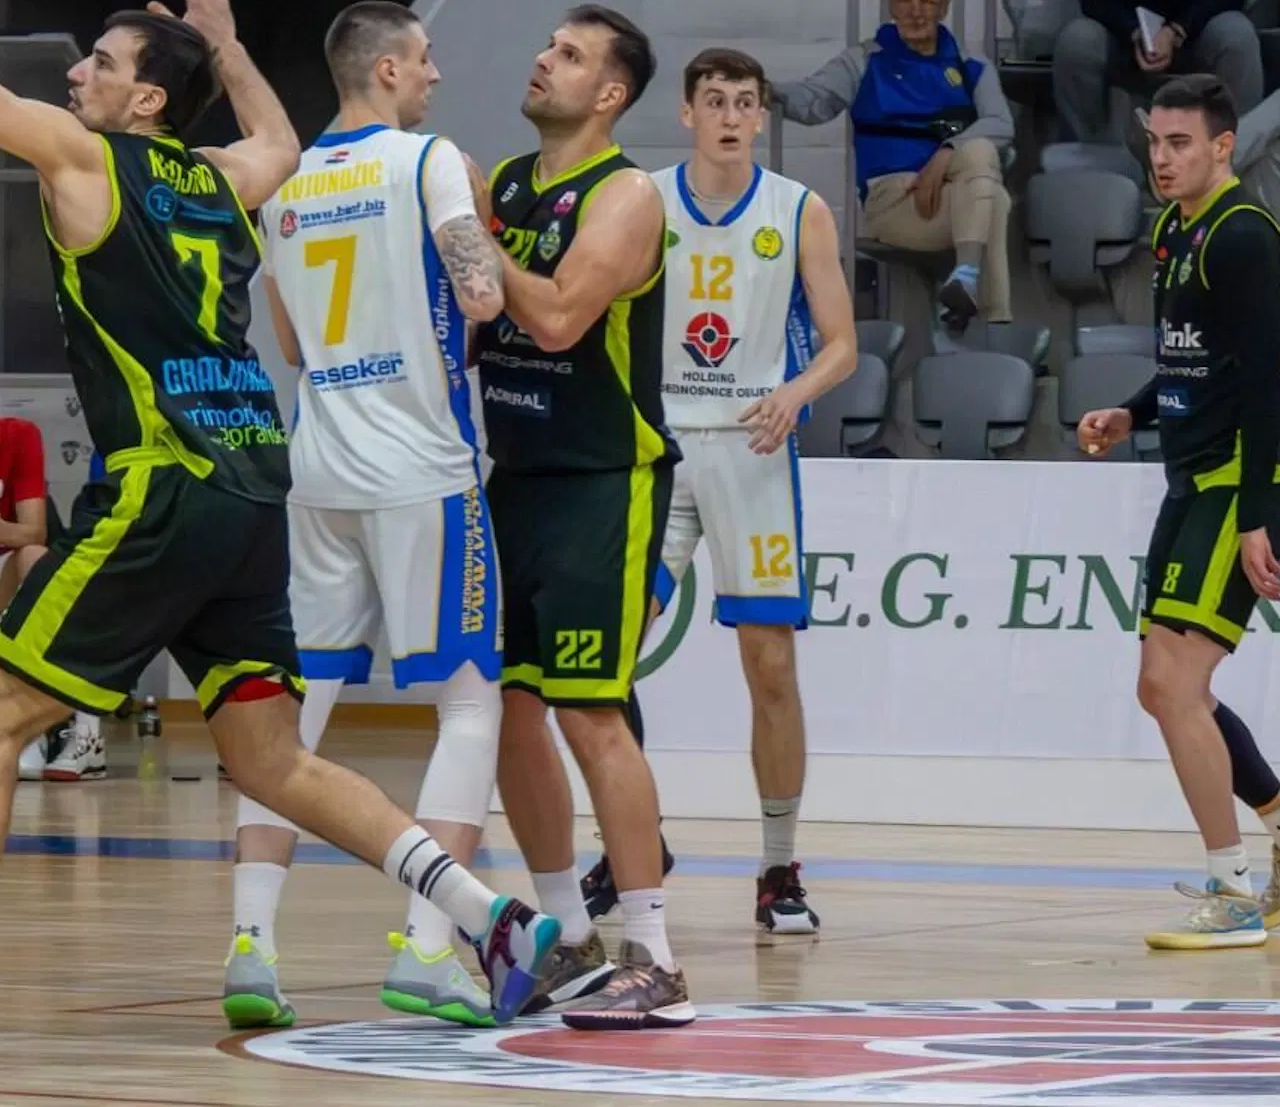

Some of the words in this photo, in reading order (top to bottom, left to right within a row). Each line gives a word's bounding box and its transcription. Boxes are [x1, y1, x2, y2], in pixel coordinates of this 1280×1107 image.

[170, 232, 223, 344] 7
[304, 235, 358, 347] 7
[688, 254, 734, 301] 12
[310, 357, 404, 385] sseker
[682, 371, 736, 383] HOLDING
[749, 534, 793, 579] 12
[1161, 562, 1183, 593] 8
[555, 629, 603, 670] 22
